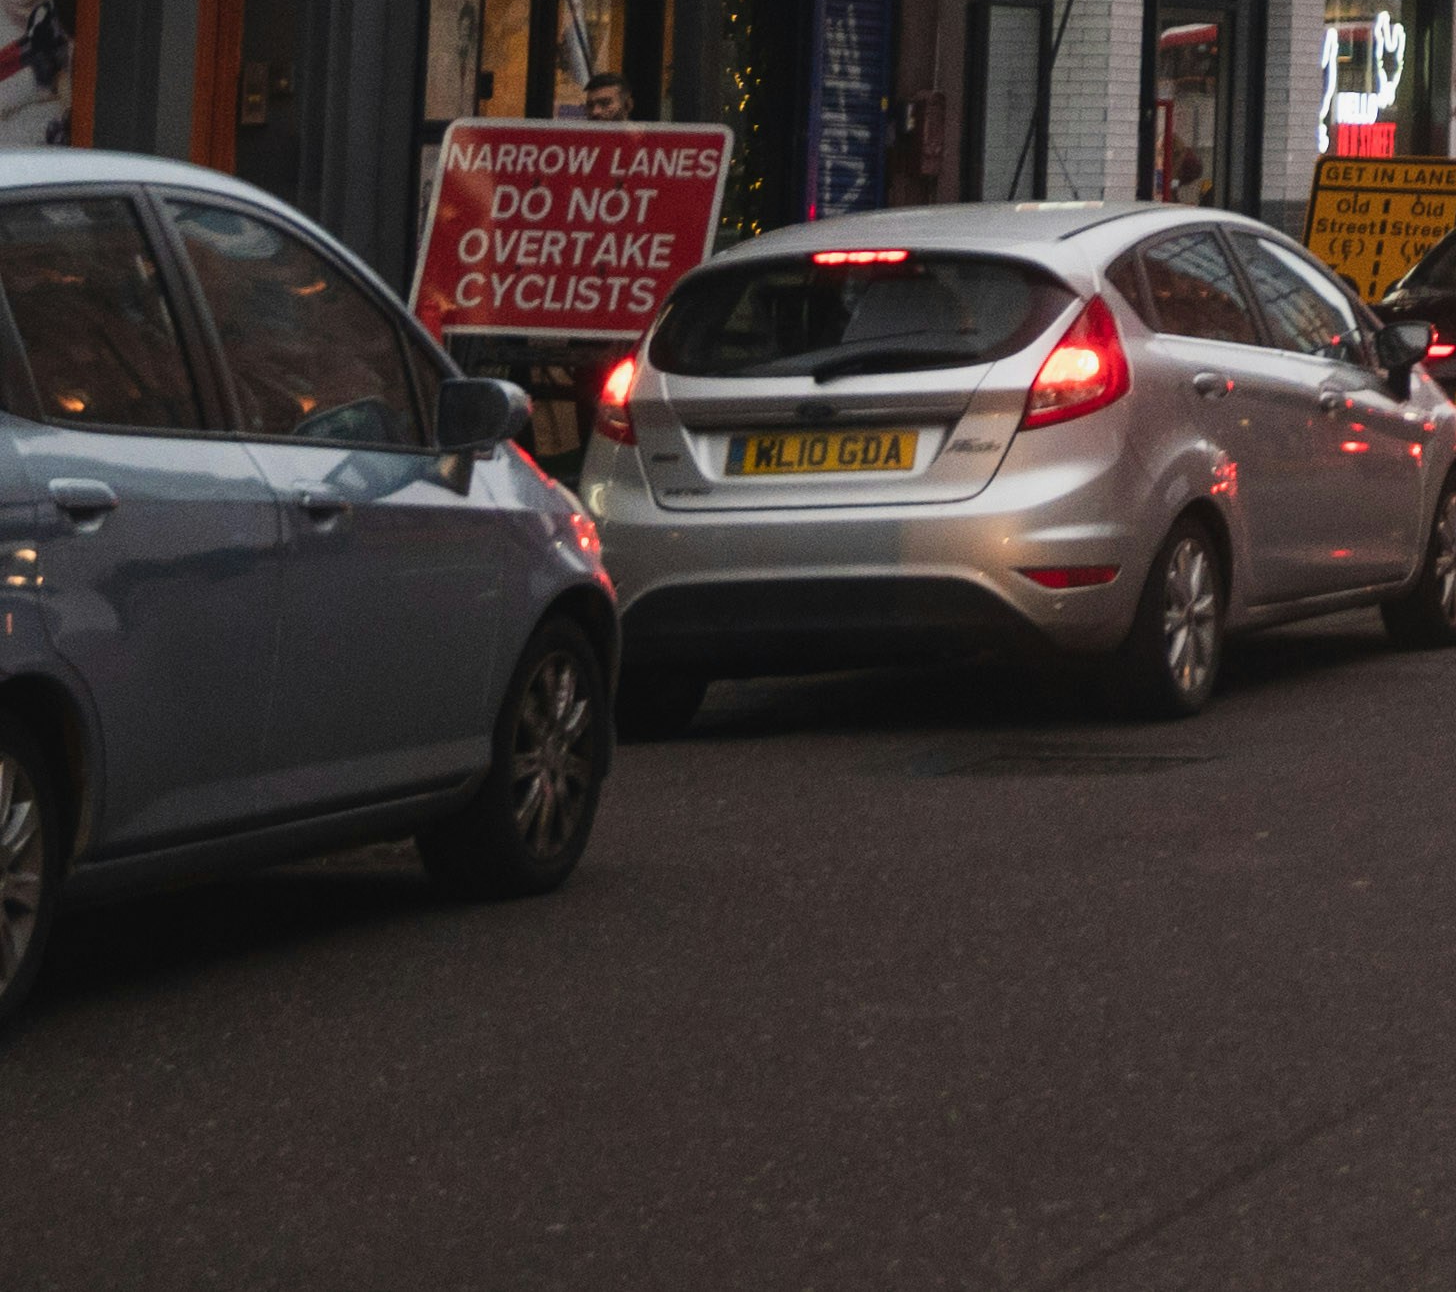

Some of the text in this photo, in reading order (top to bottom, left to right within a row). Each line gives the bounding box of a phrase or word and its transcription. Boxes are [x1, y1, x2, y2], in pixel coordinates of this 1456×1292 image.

[449, 143, 719, 178] NARROW LANES
[1327, 167, 1456, 185] GET IN LANE
[491, 185, 658, 224] DO NOT
[1336, 197, 1370, 215] Old
[1411, 198, 1443, 217] Old
[1316, 218, 1382, 235] Street
[458, 228, 676, 269] OVERTAKE
[456, 273, 657, 313] CYCLISTS
[838, 436, 902, 467] GDA
